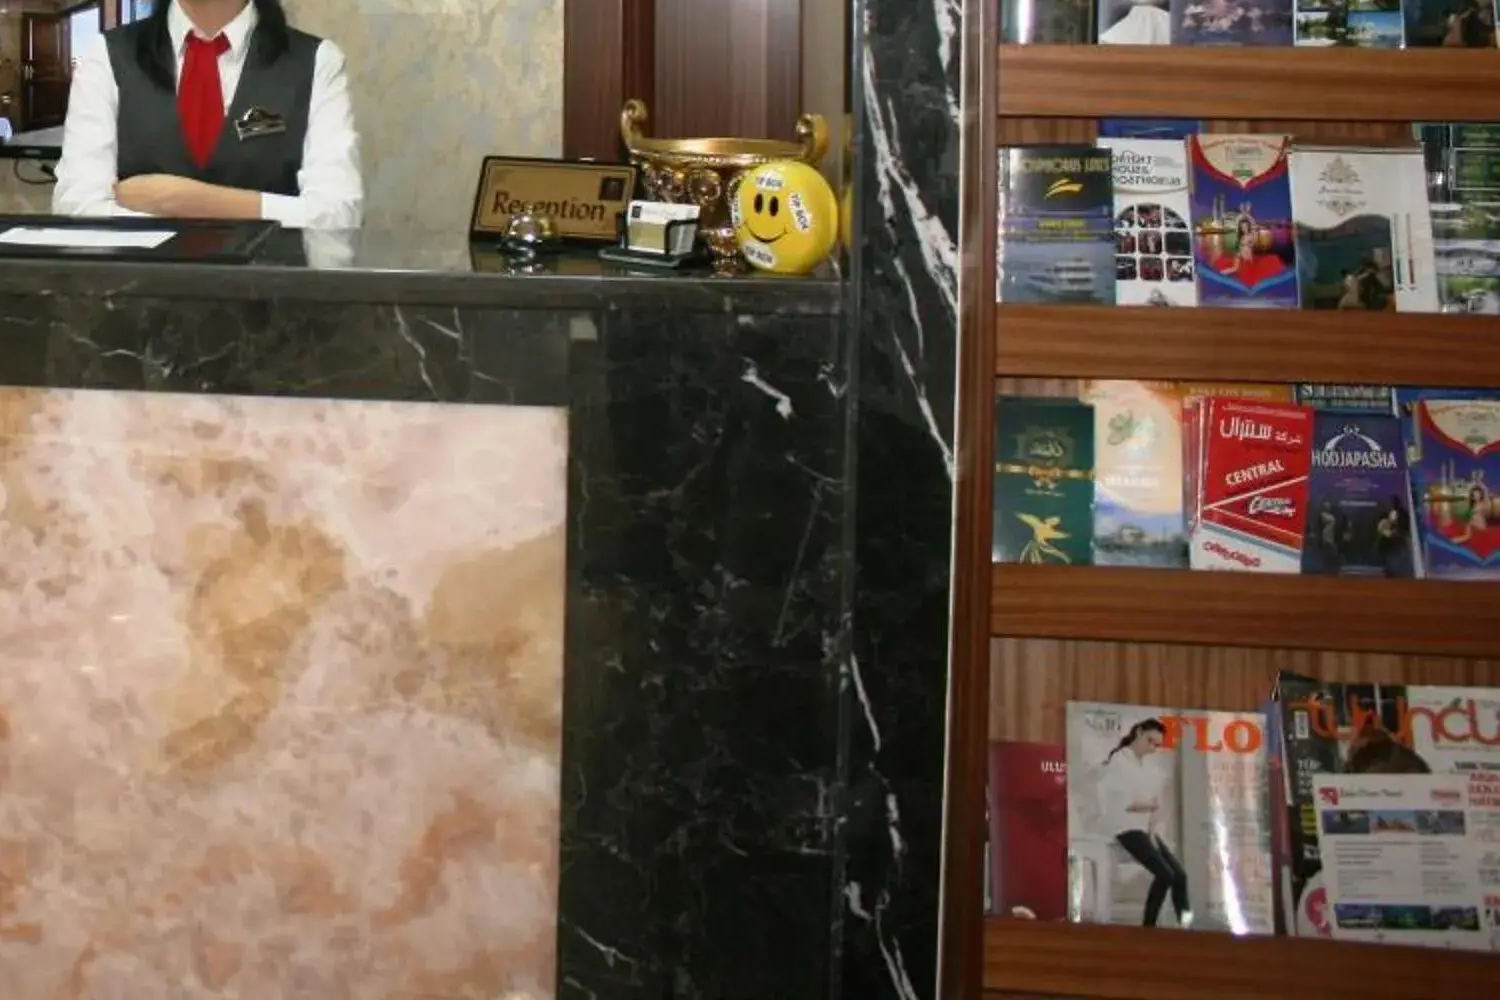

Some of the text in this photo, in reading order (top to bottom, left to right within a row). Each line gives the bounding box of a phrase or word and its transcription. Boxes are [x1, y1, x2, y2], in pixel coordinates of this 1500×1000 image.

[492, 190, 606, 222] Reception
[1225, 459, 1285, 487] CENTRAL
[1311, 449, 1398, 469] HODJAPASHA
